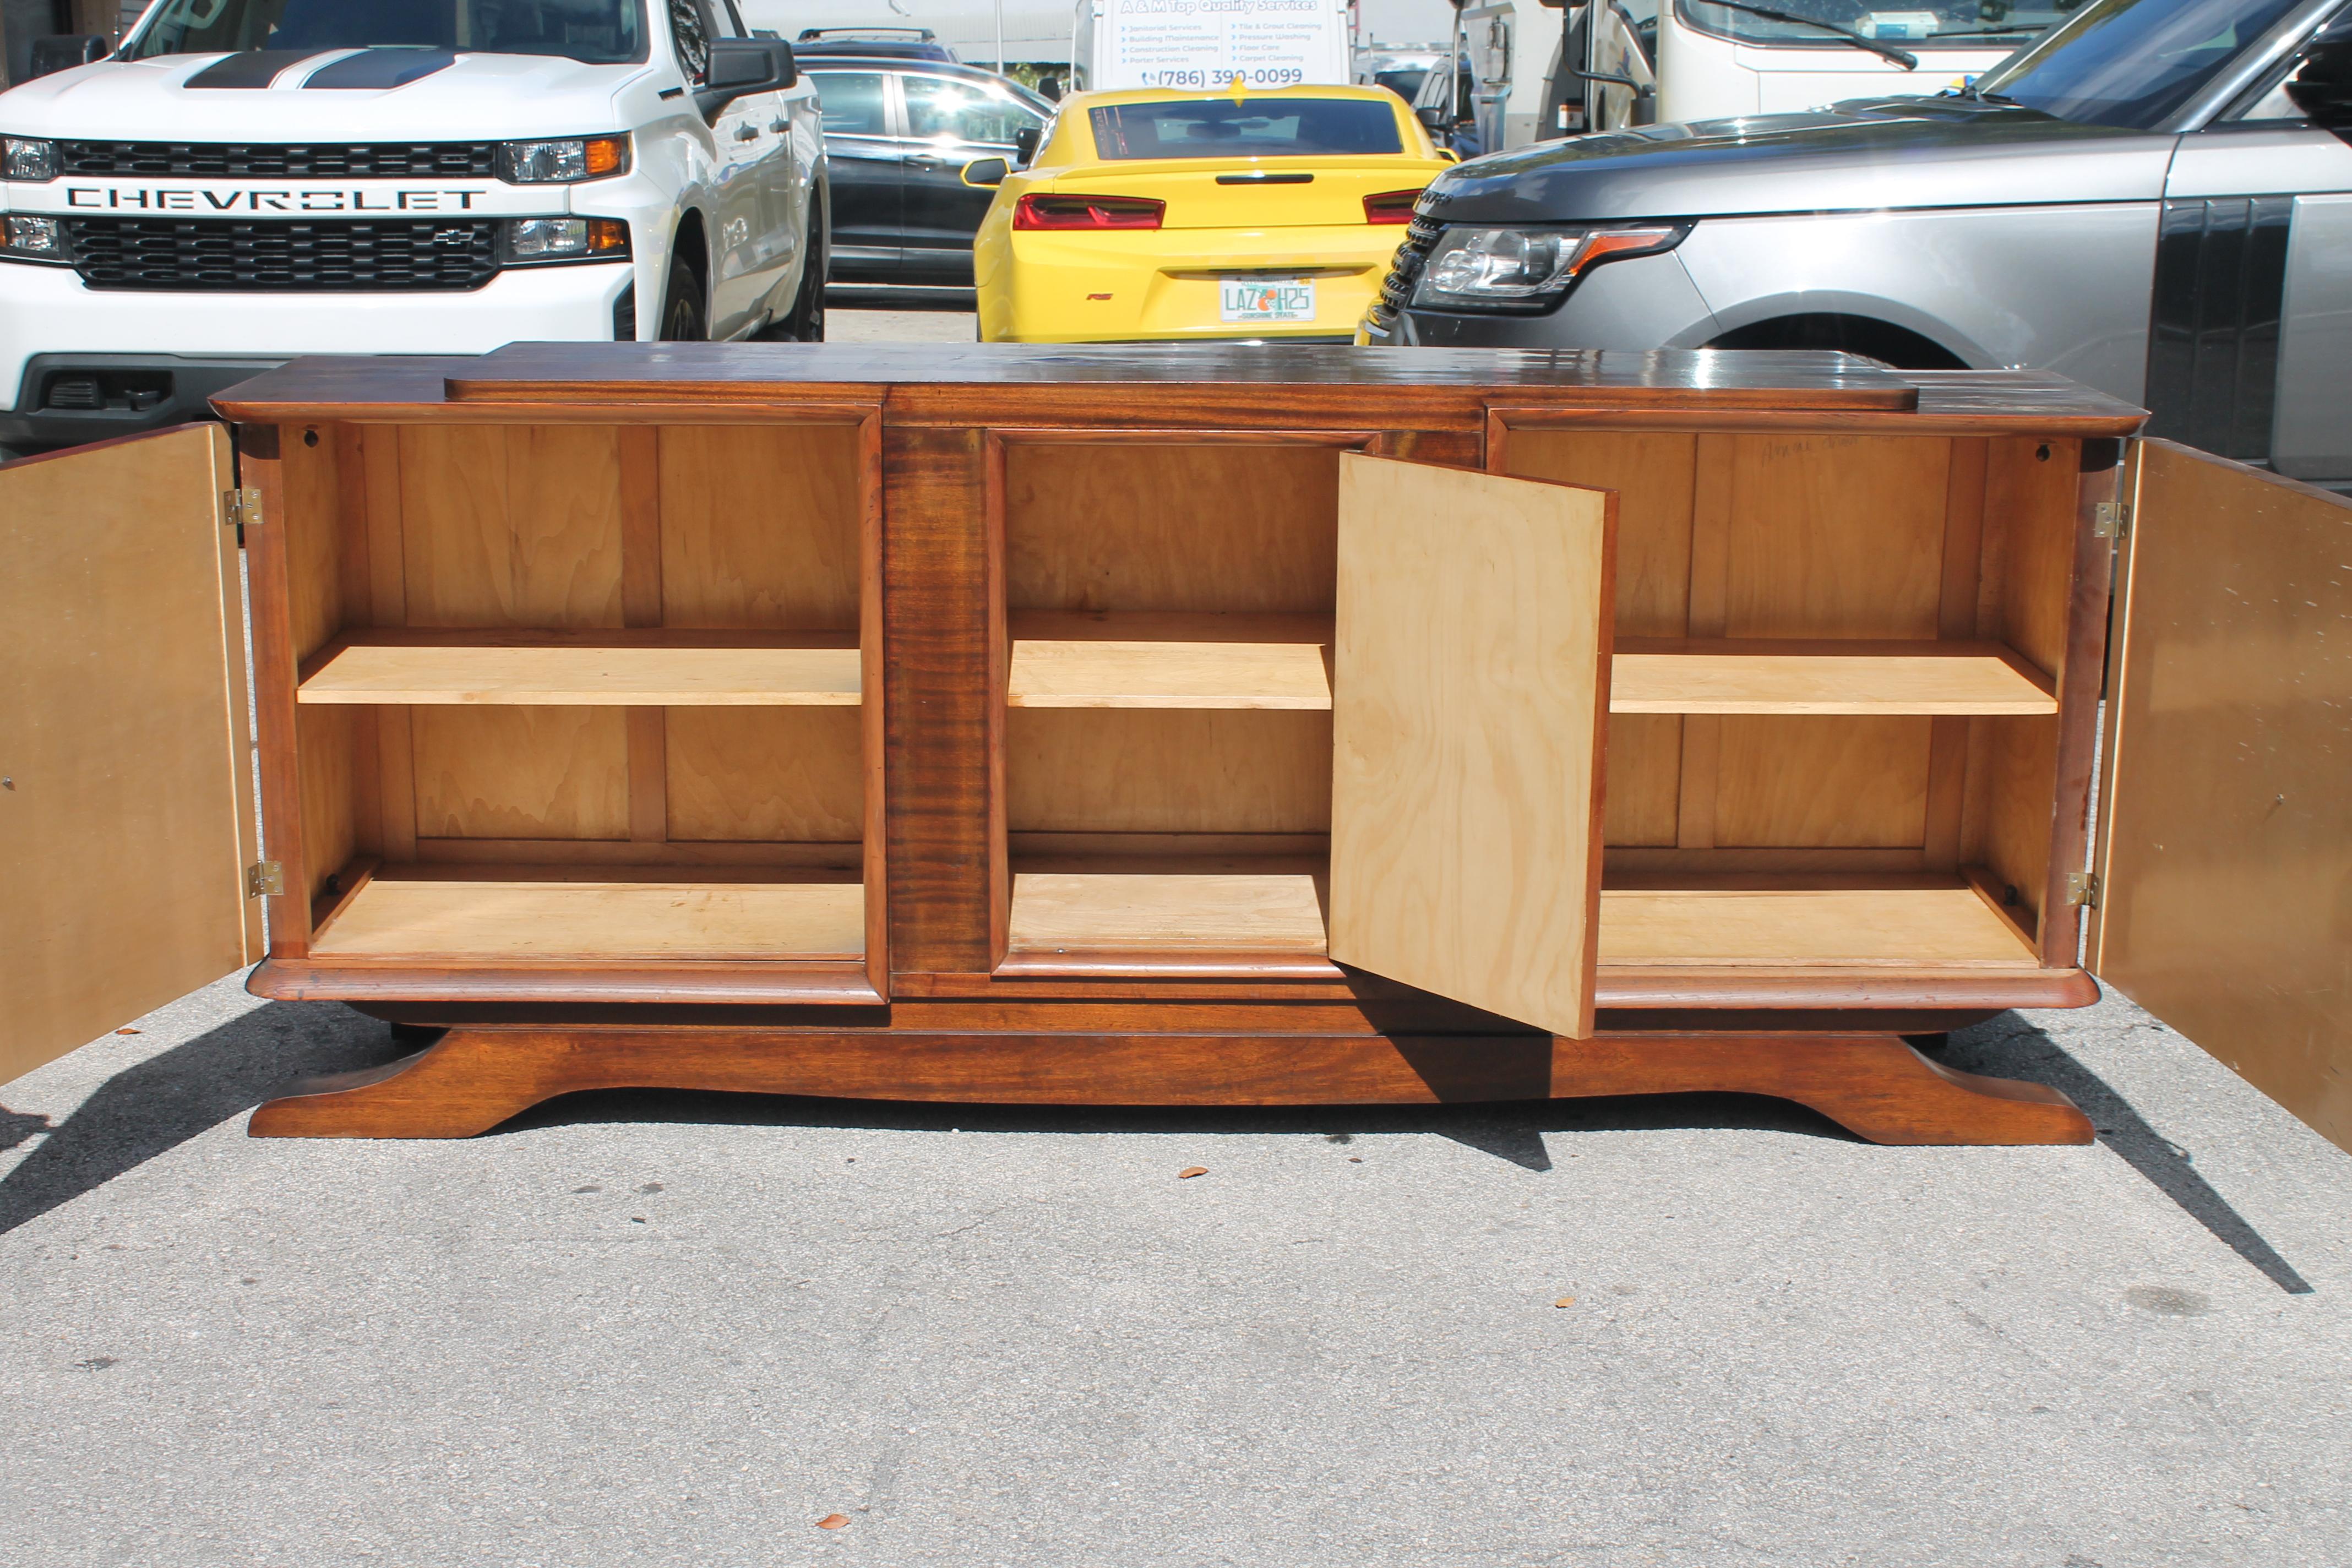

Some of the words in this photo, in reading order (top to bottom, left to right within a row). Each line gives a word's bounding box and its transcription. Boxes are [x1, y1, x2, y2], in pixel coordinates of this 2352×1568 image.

[1120, 0, 1134, 14] A
[1136, 0, 1149, 14] &
[1151, 0, 1167, 13] M
[1170, 0, 1196, 15] Top
[1199, 0, 1254, 14] Quality
[1257, 0, 1317, 11] Services
[1287, 22, 1321, 30] Cleaning
[1159, 70, 1205, 88] (786)
[1212, 68, 1302, 84] 390-0099
[67, 188, 487, 211] CHEVROLET
[1225, 288, 1257, 311] LAZ
[1278, 288, 1309, 310] H25
